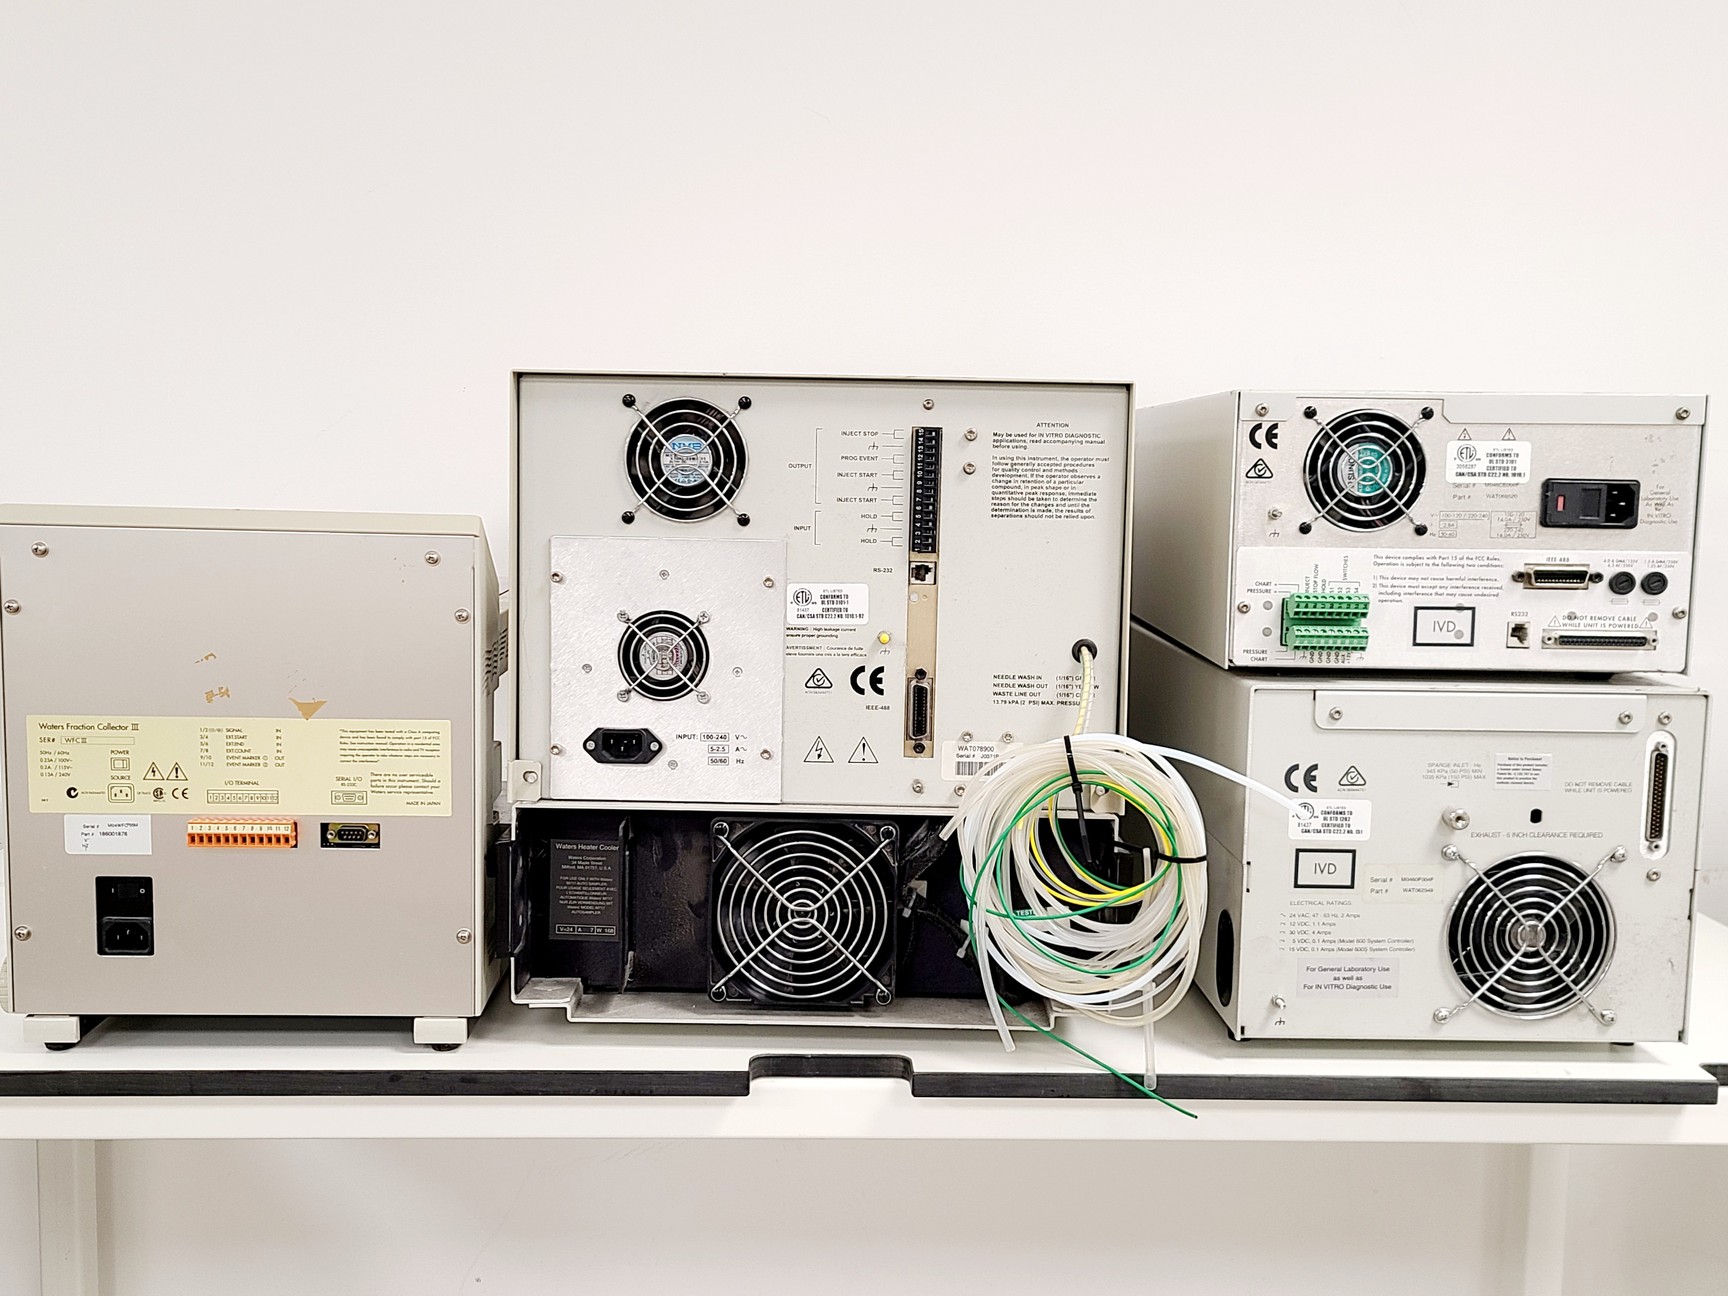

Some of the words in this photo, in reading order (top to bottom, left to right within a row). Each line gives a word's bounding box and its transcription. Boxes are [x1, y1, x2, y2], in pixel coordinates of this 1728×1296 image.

[1249, 422, 1278, 449] CE
[1433, 620, 1456, 632] IVD
[850, 665, 884, 696] CE
[1284, 764, 1318, 793] CE
[1314, 863, 1337, 874] IVD
